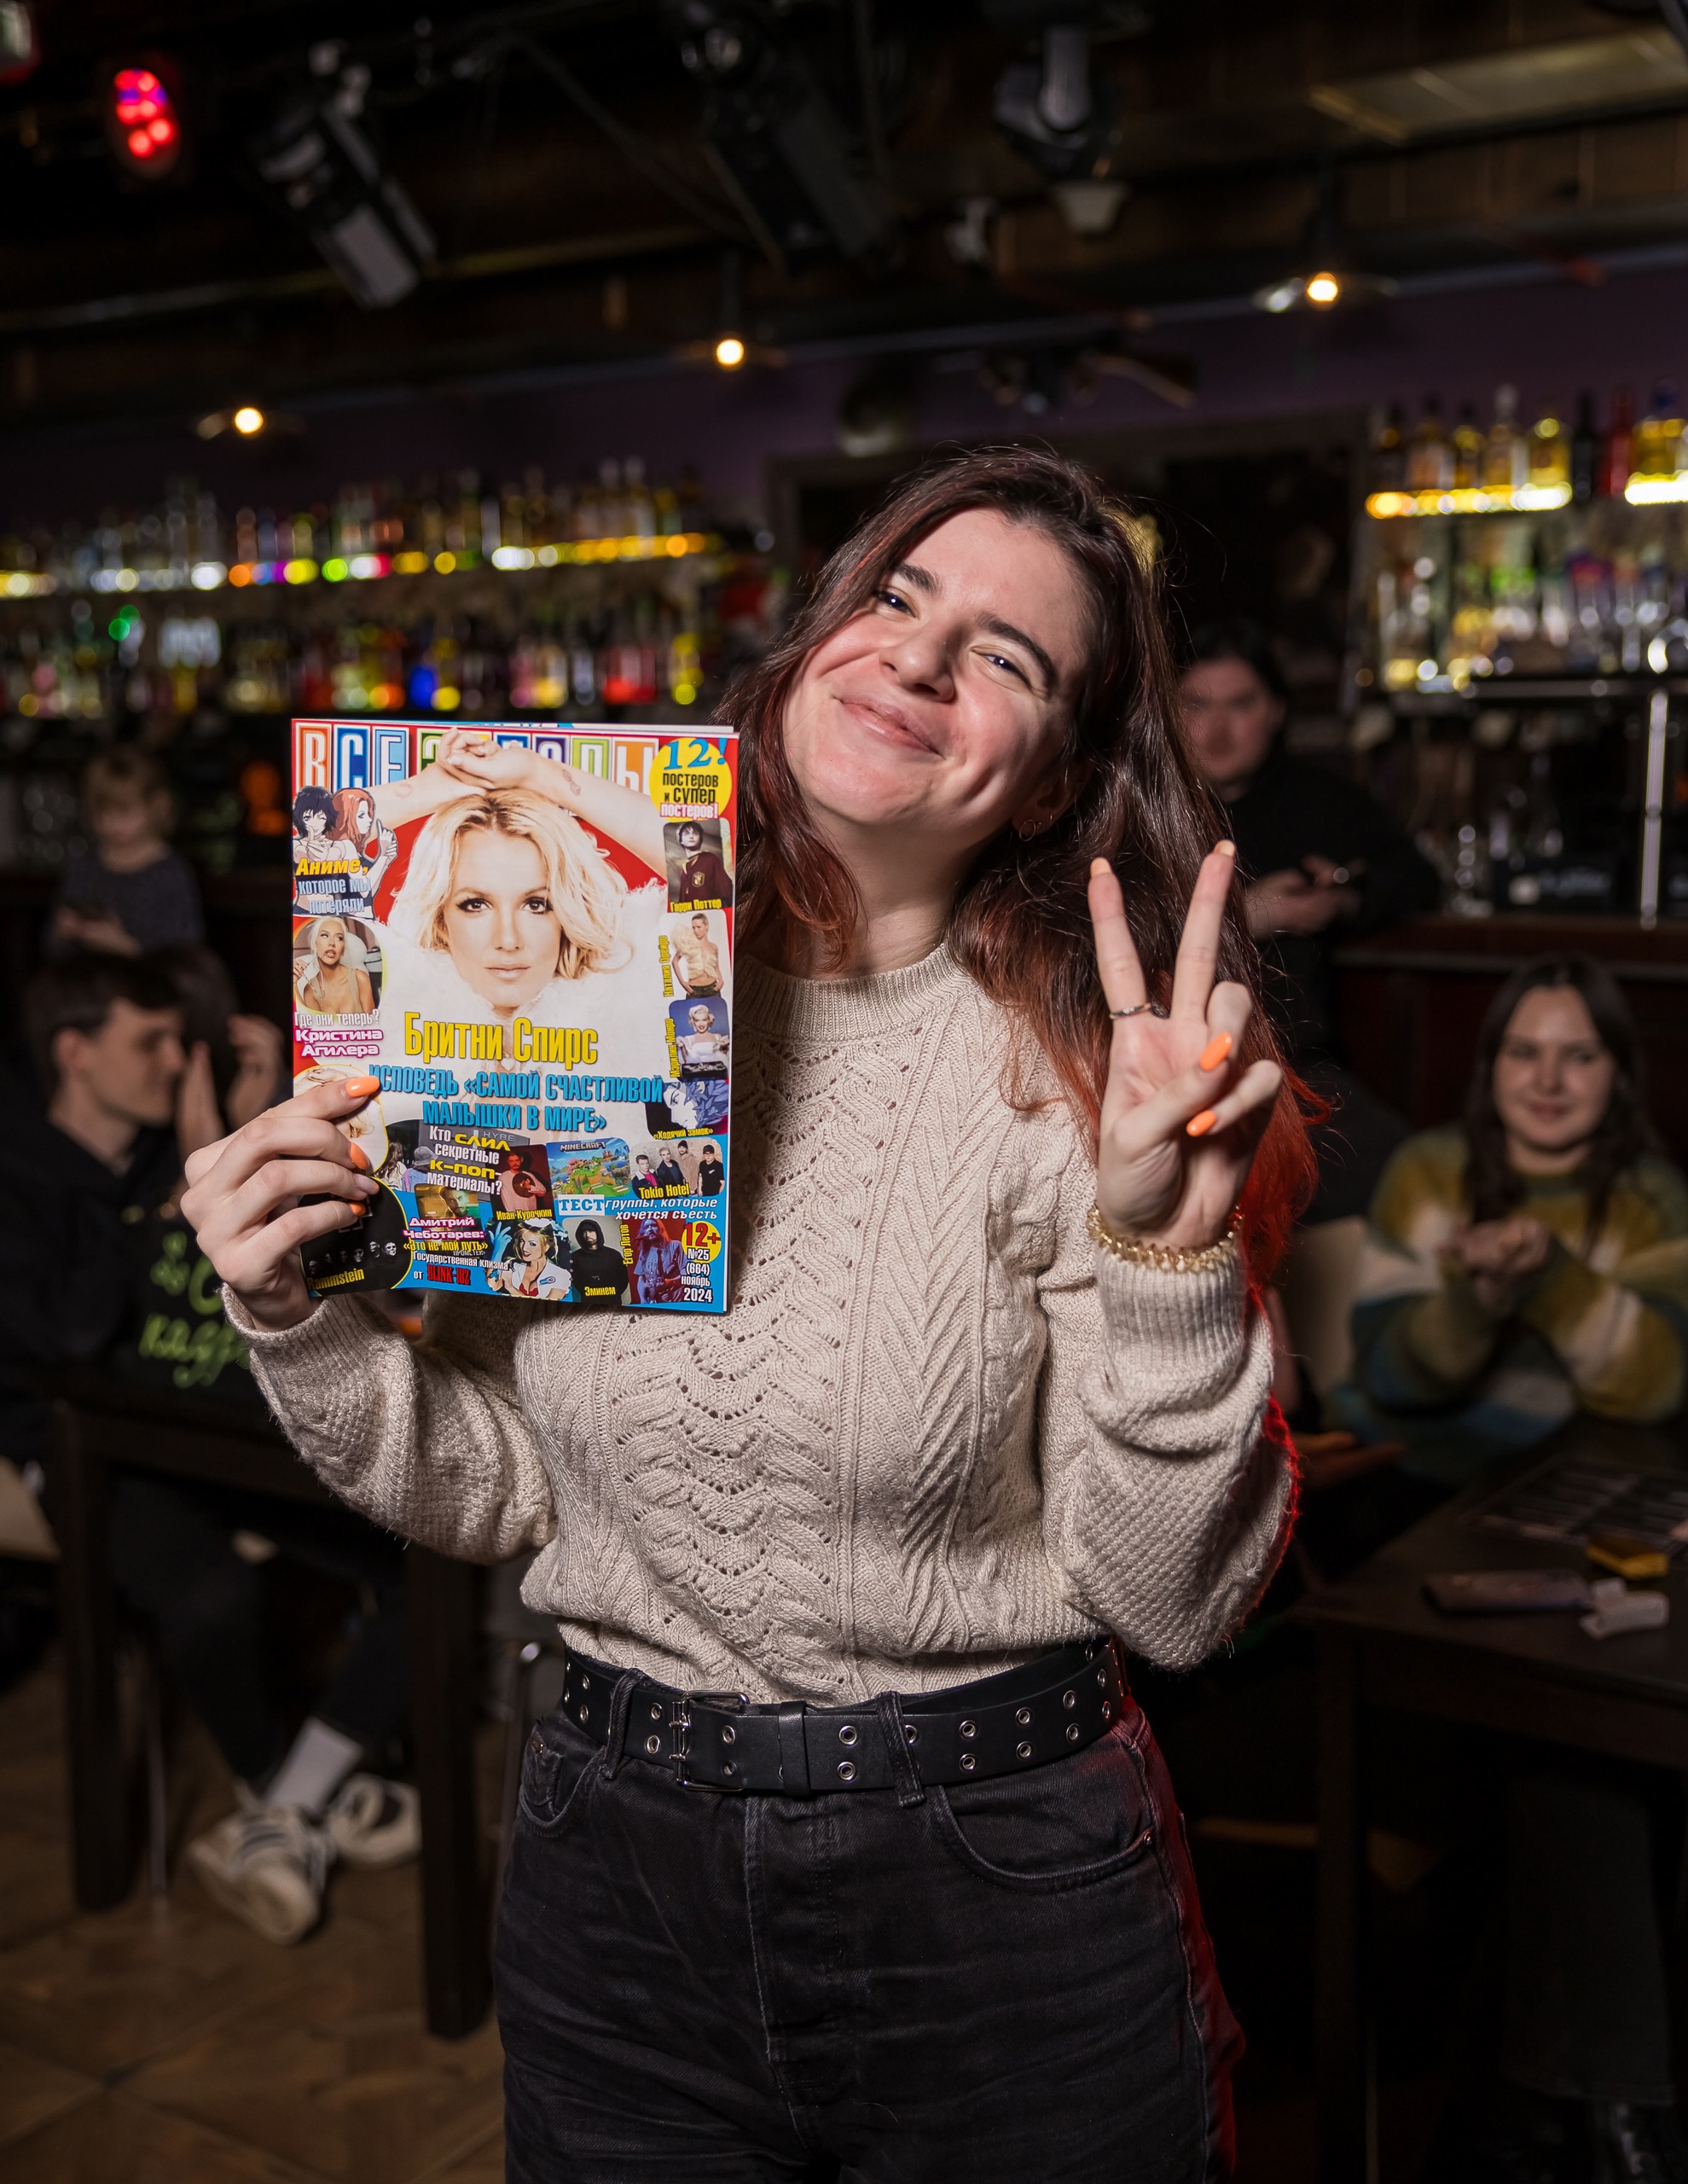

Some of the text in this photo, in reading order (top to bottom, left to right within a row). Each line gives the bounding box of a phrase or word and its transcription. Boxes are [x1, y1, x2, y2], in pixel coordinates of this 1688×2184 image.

[664, 737, 728, 770] 12!
[663, 773, 719, 790] постеров
[660, 803, 719, 821] постеров!
[295, 857, 369, 876] Аниме,
[298, 878, 372, 897] которое мы
[309, 897, 365, 916] потеряли
[294, 1008, 380, 1027] Где они теперь?
[295, 1029, 383, 1043] Кристина
[404, 1012, 598, 1071] Бритни Спирс
[301, 1044, 380, 1058] Агилера
[463, 1070, 541, 1100] «САМОЙ
[545, 1073, 664, 1104] СЧАСТЛИВОЙ
[422, 1101, 607, 1133] МАЛЫШКИ В МИРЕ»
[429, 1125, 451, 1142] Кто
[434, 1143, 500, 1165] секретные
[560, 1141, 606, 1153] MINECRAFT
[427, 1172, 502, 1195] материалы?
[639, 1183, 690, 1199] Tokio Hotel
[559, 1199, 718, 1211] ТЕСТ группы, которые
[409, 1217, 474, 1227] Дмитрий
[496, 1209, 553, 1221] Иван Курочкин
[615, 1211, 717, 1220] хочется съесть
[403, 1230, 484, 1240] Чеботарев:
[620, 1223, 634, 1264] Егор Летов
[684, 1223, 721, 1247] 12+
[428, 1242, 438, 1252] не
[441, 1240, 460, 1252] мой
[461, 1240, 488, 1252] путь»
[687, 1248, 710, 1260] №25
[413, 1251, 509, 1270] Государственная клизма
[686, 1262, 711, 1276] (664)
[307, 1268, 365, 1291] Rammstein
[414, 1270, 423, 1280] от
[427, 1264, 471, 1286] BLINK-182
[681, 1275, 711, 1287] ноябрь
[584, 1286, 617, 1297] Эминем
[683, 1287, 713, 1303] 2024
